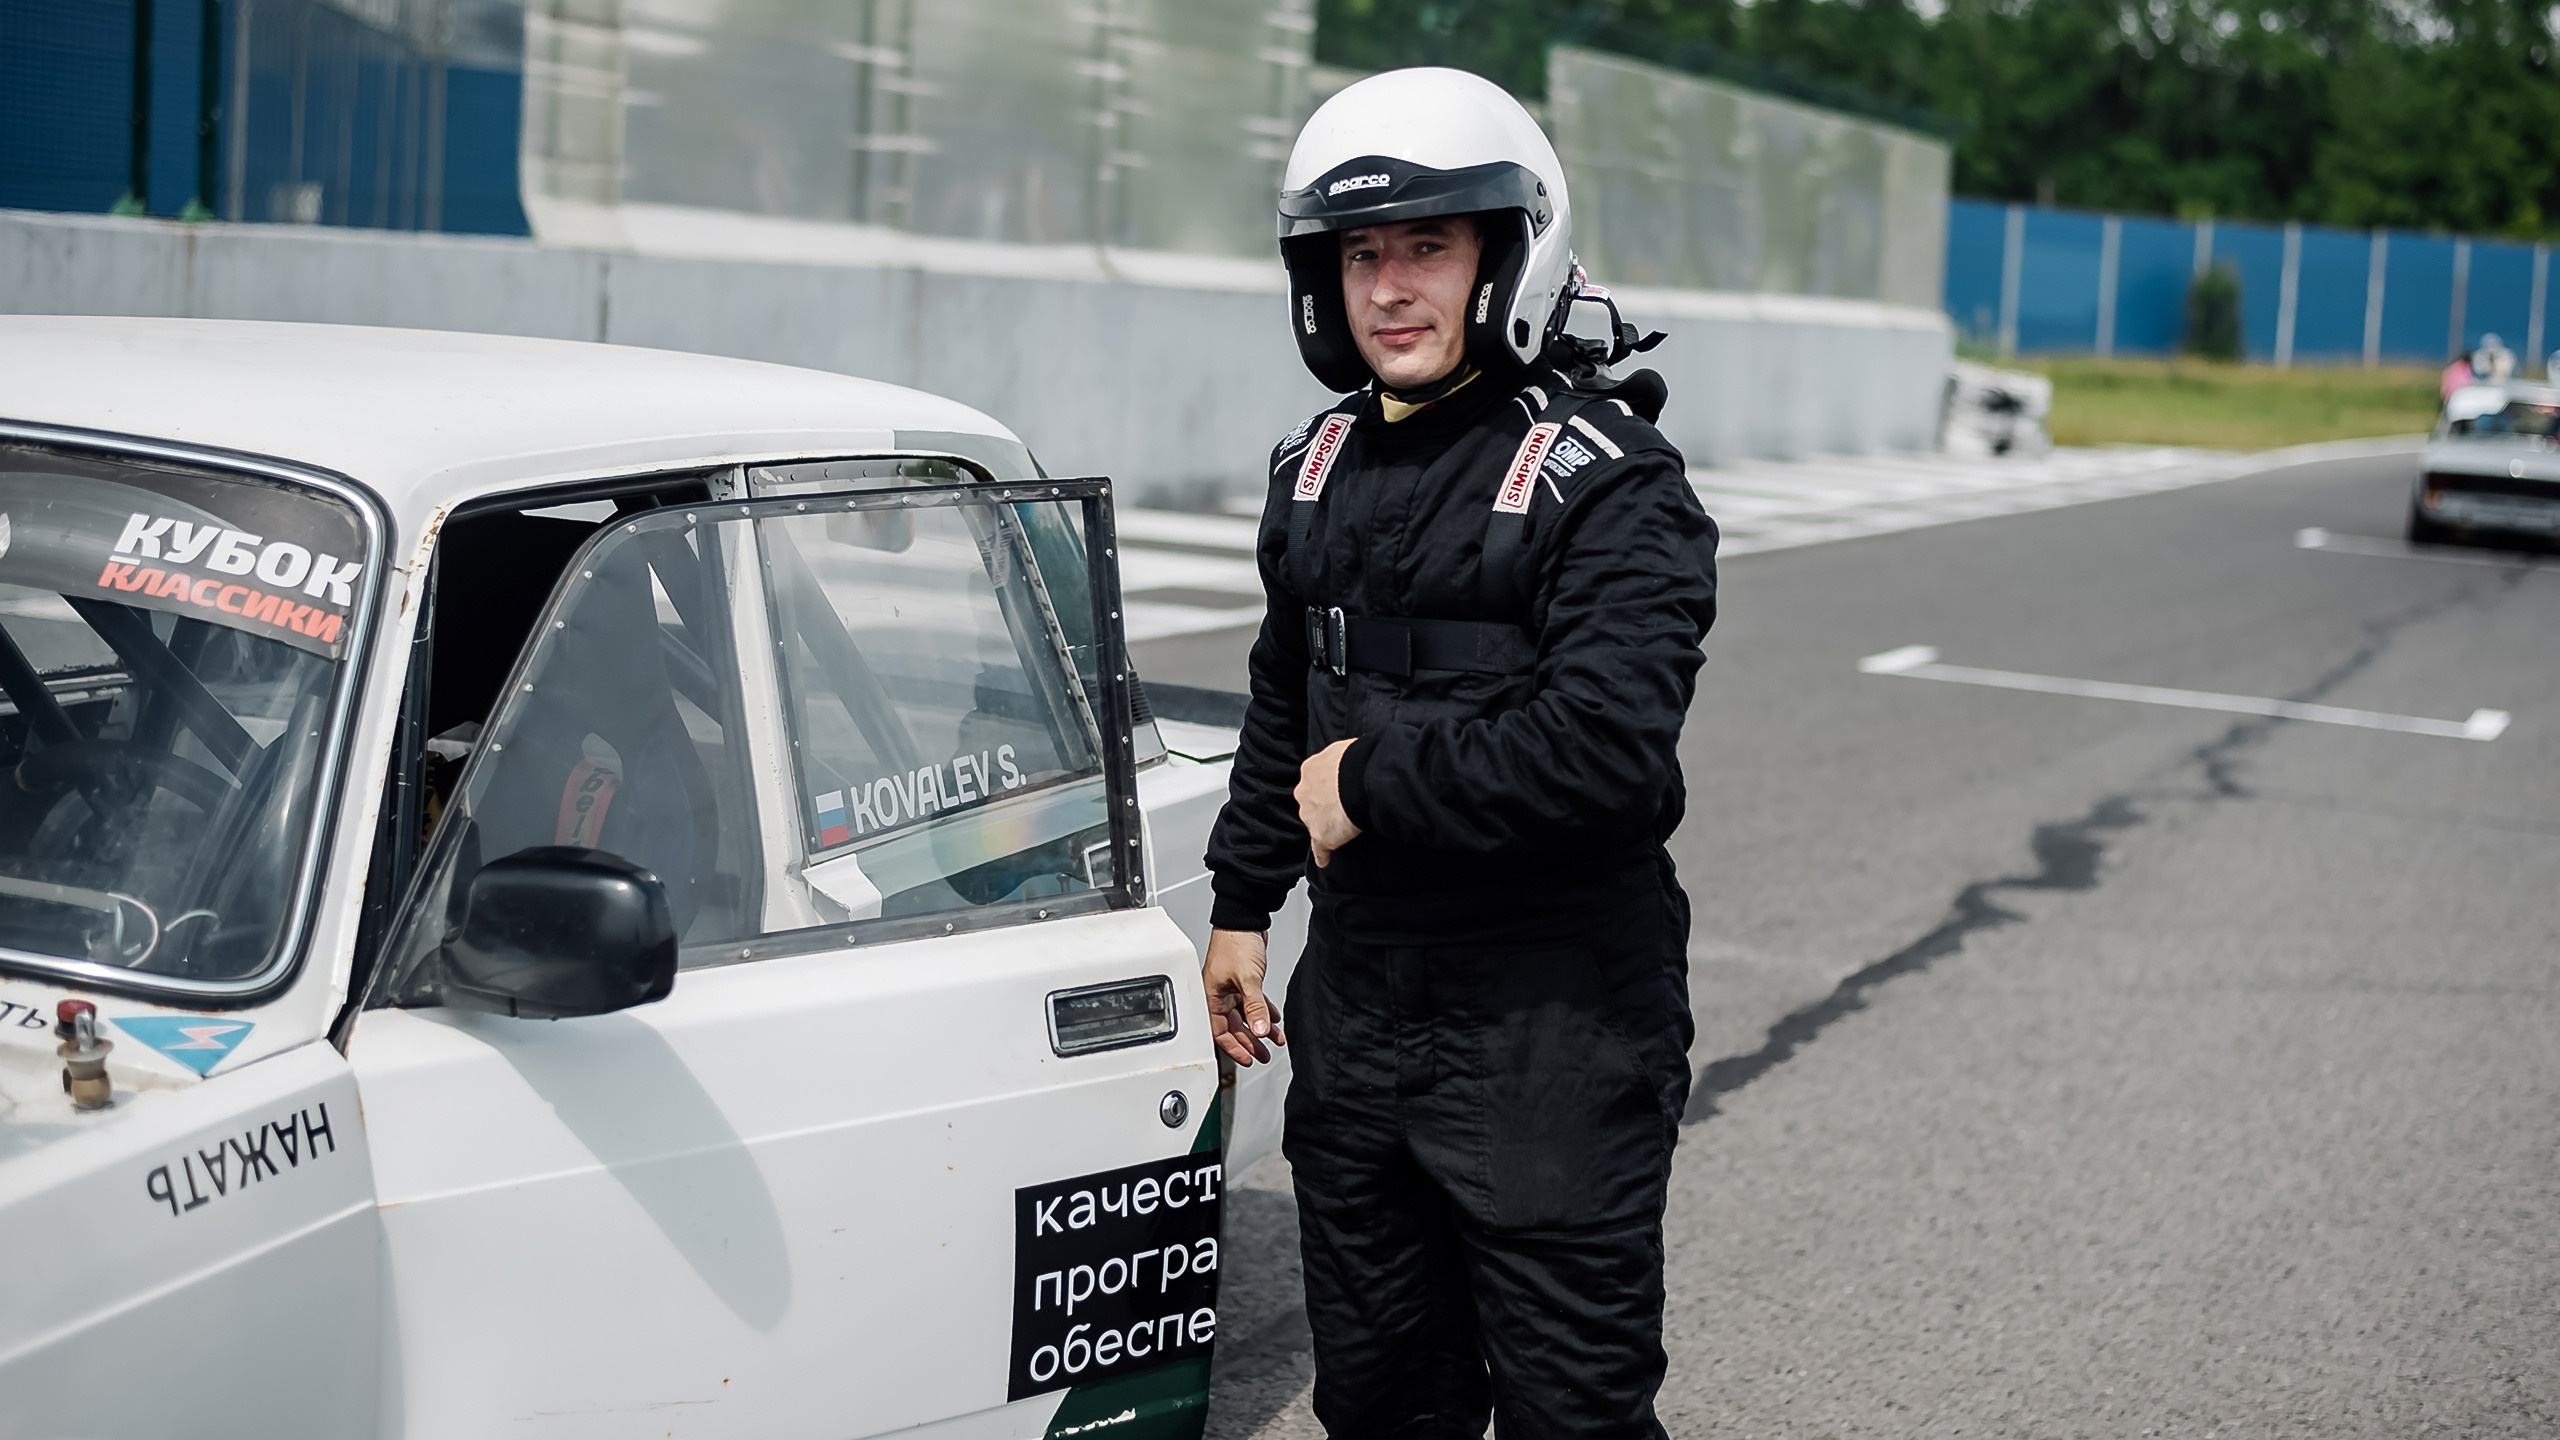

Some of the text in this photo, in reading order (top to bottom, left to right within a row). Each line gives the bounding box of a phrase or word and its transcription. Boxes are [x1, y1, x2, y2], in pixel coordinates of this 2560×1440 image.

[1303, 422, 1342, 491] SIMPSON
[1507, 432, 1546, 502] SIMPSON
[1554, 440, 1591, 467] OMP
[111, 513, 363, 606] КУБОК
[98, 561, 343, 643] КЛАССИКИ
[851, 744, 1027, 834] KOVALEV S.
[146, 1102, 336, 1217] НАЖАТЬ
[1035, 1164, 1222, 1237] качест
[1034, 1237, 1219, 1316] програ
[1029, 1307, 1217, 1382] обеспе
